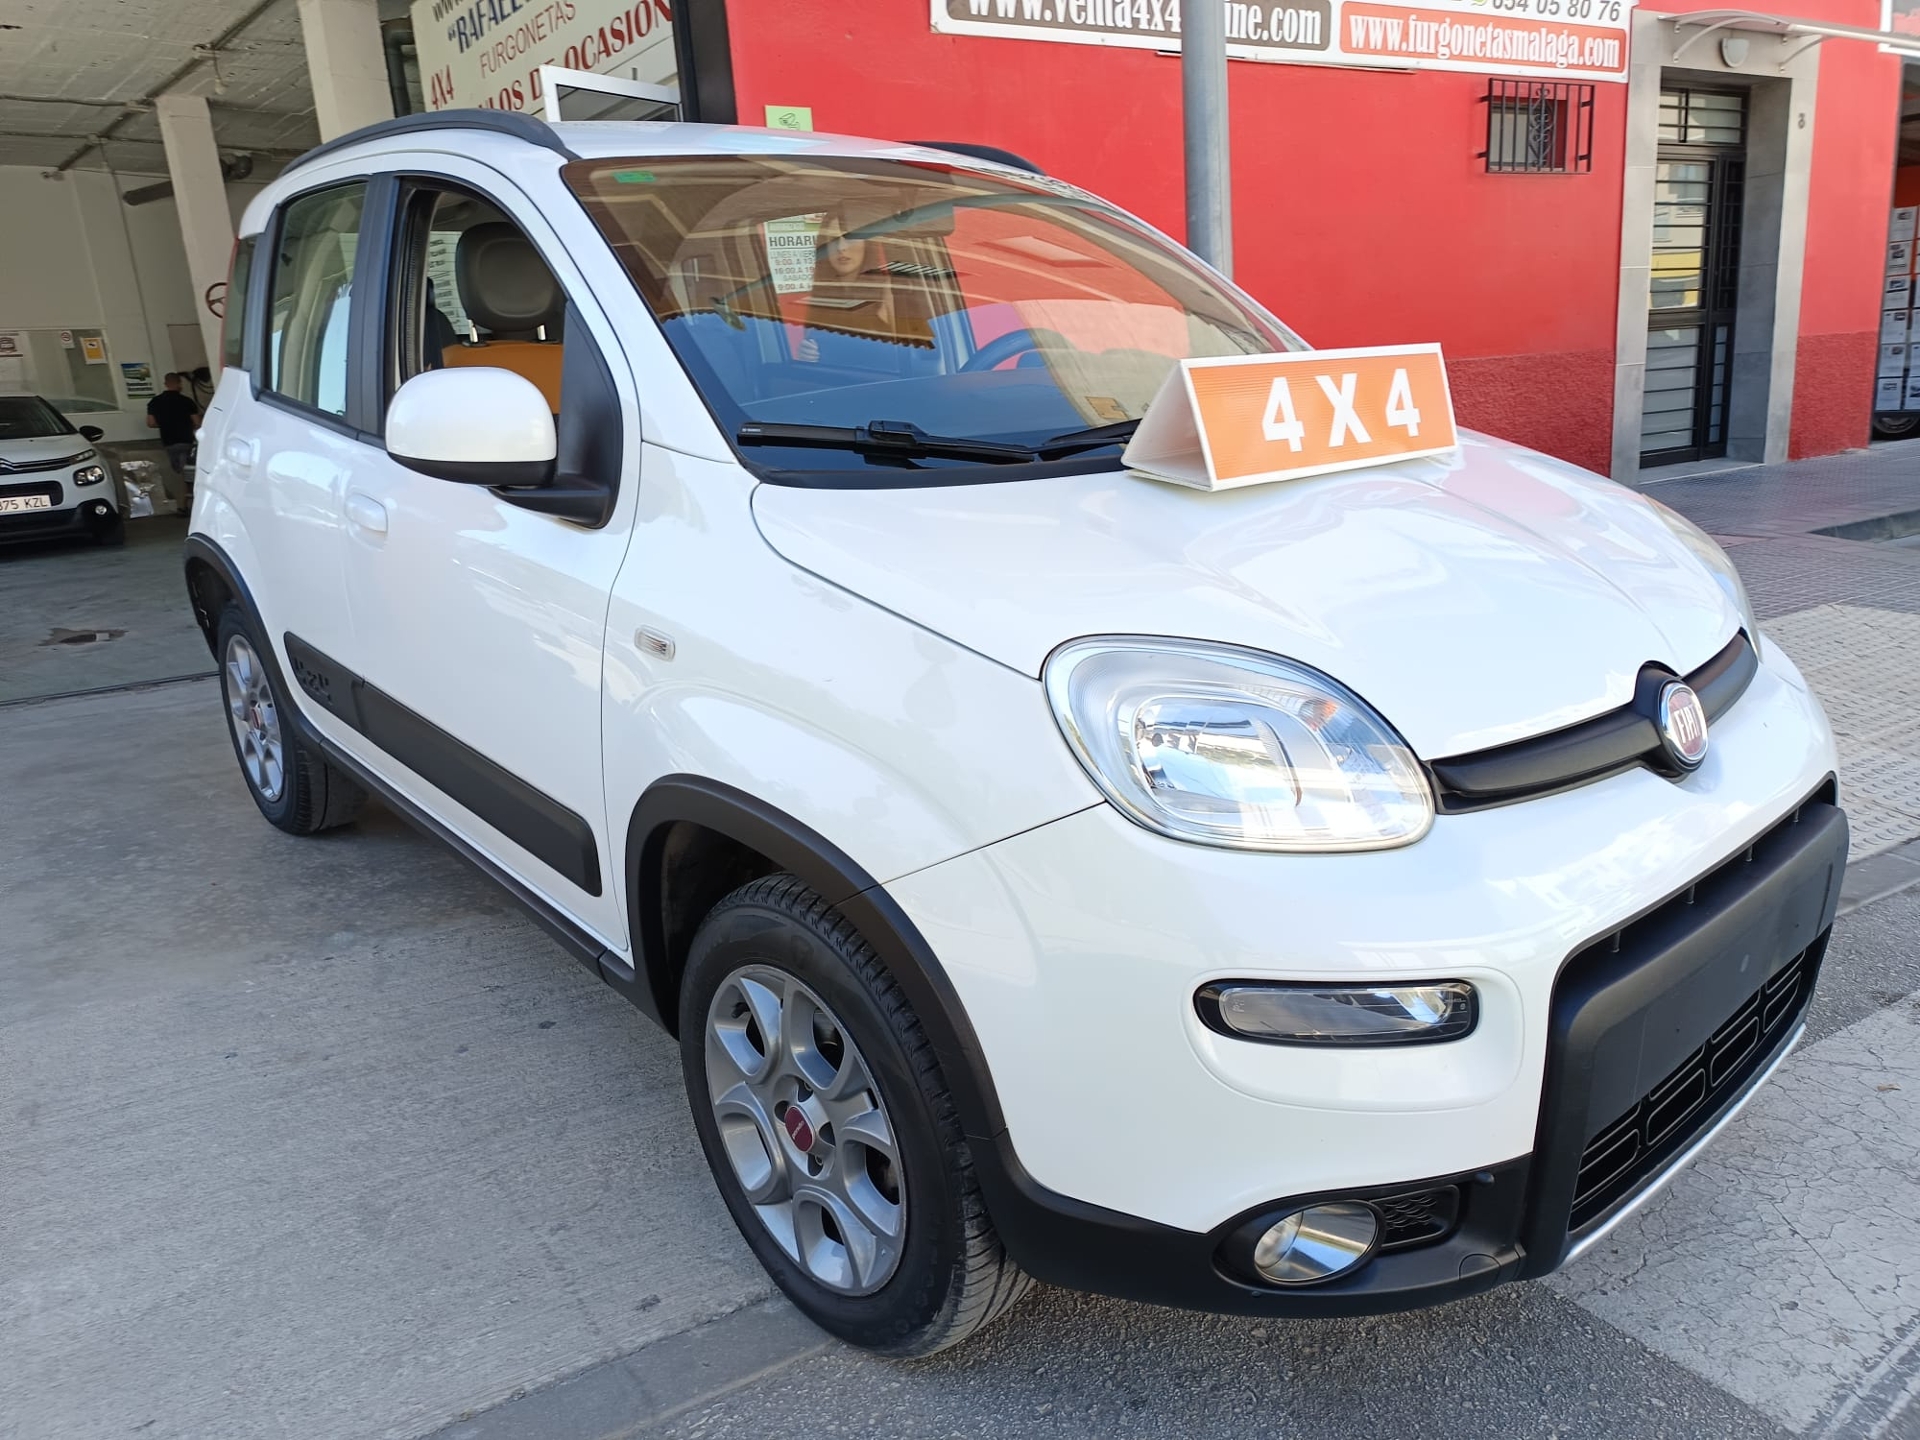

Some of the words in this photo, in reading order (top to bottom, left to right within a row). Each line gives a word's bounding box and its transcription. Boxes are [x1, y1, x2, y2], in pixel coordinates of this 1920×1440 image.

[1537, 0, 1559, 15] 05
[1567, 0, 1590, 18] 80
[1598, 0, 1621, 22] 76
[480, 0, 576, 79] FURGONETAS
[1349, 14, 1620, 69] www.furgonetasmalaga.com
[1262, 377, 1305, 452] 4
[1315, 373, 1373, 447] X
[1385, 368, 1421, 437] 4
[24, 497, 48, 509] KZL
[1674, 704, 1701, 744] FIAT
